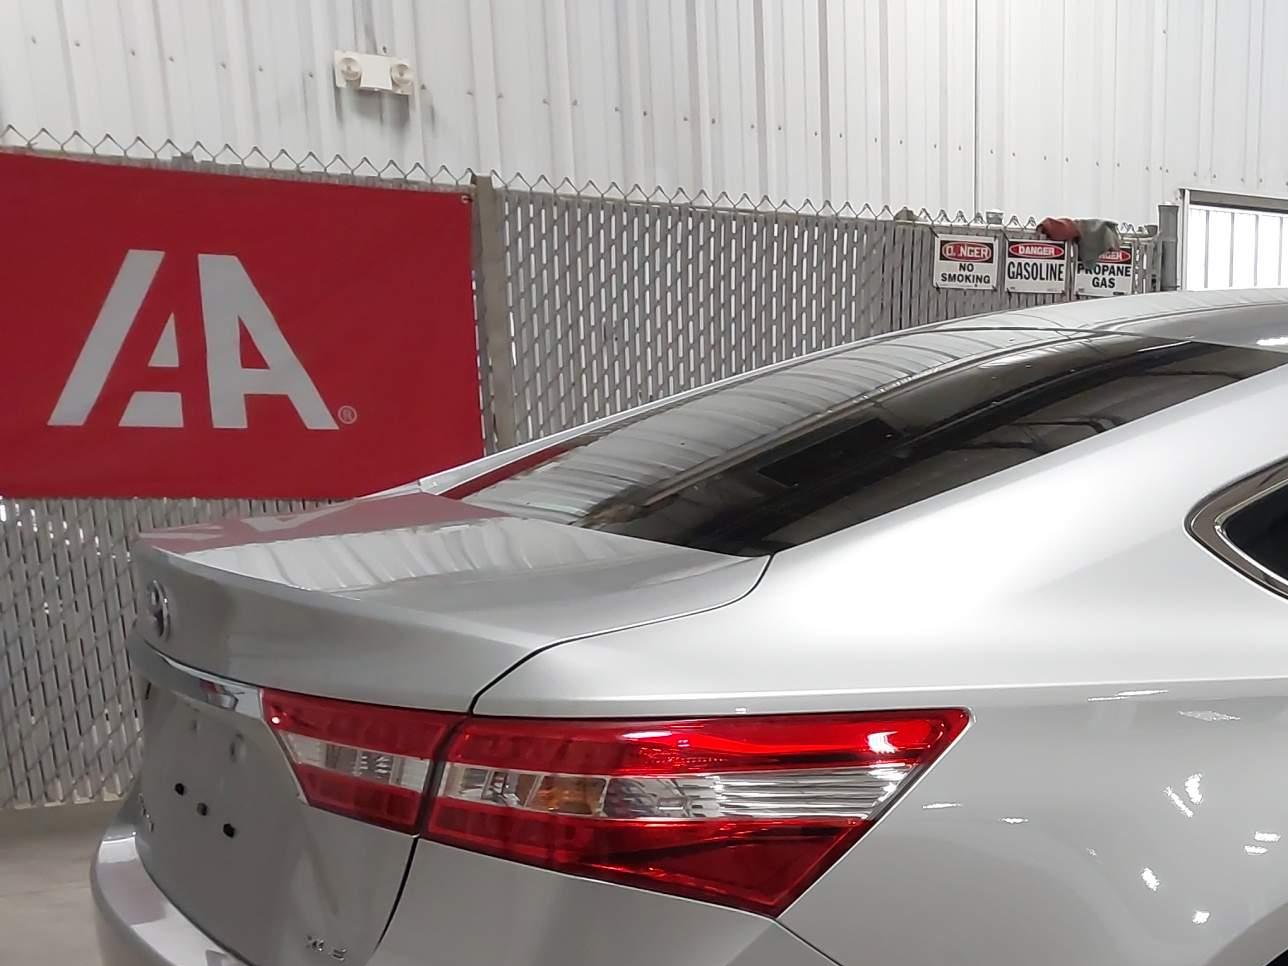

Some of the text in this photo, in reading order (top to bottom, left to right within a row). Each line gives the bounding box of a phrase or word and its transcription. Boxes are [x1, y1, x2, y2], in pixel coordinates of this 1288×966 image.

[945, 244, 989, 258] DNGER
[1018, 245, 1056, 256] DANGER
[959, 263, 974, 273] NO
[1007, 261, 1065, 281] GASOLINE
[941, 273, 991, 284] SMOKING
[1092, 277, 1116, 289] GAS
